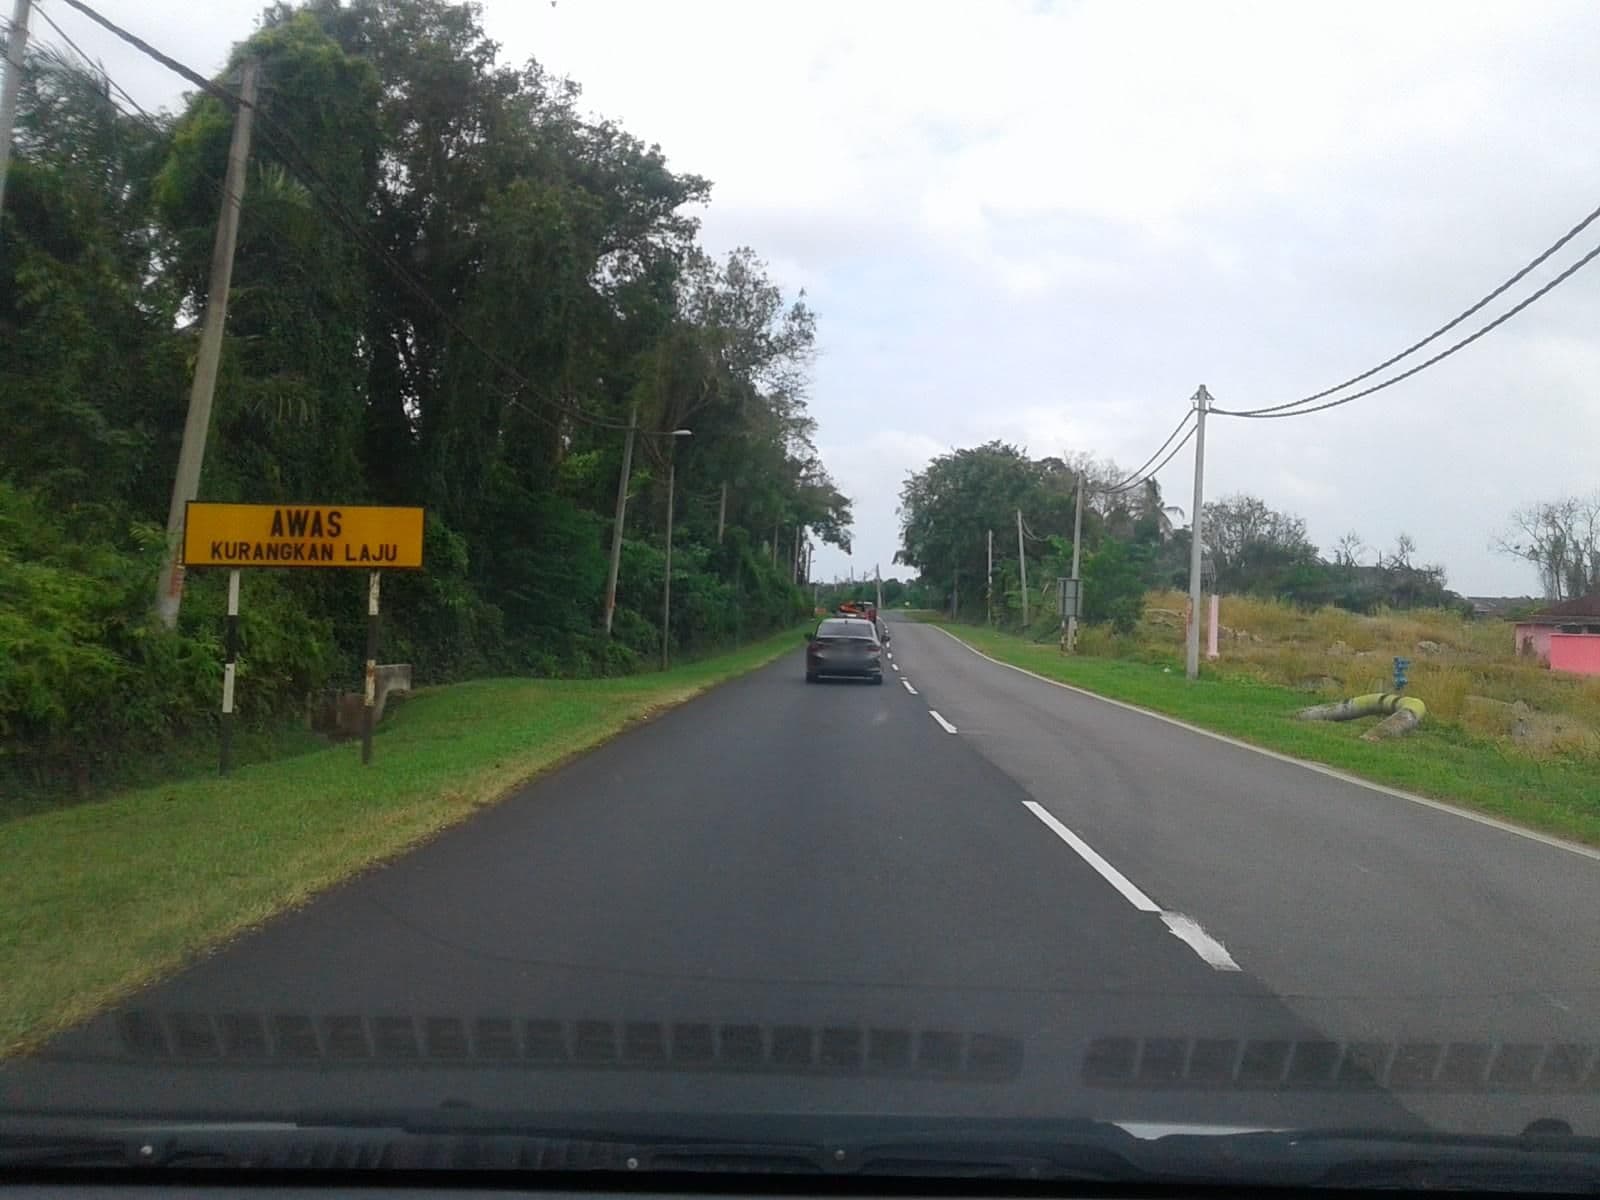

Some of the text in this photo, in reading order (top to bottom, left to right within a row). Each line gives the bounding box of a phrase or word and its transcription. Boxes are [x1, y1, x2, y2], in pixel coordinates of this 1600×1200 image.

[270, 509, 343, 538] AWAS
[211, 541, 398, 563] KURANGKAN LAJU
